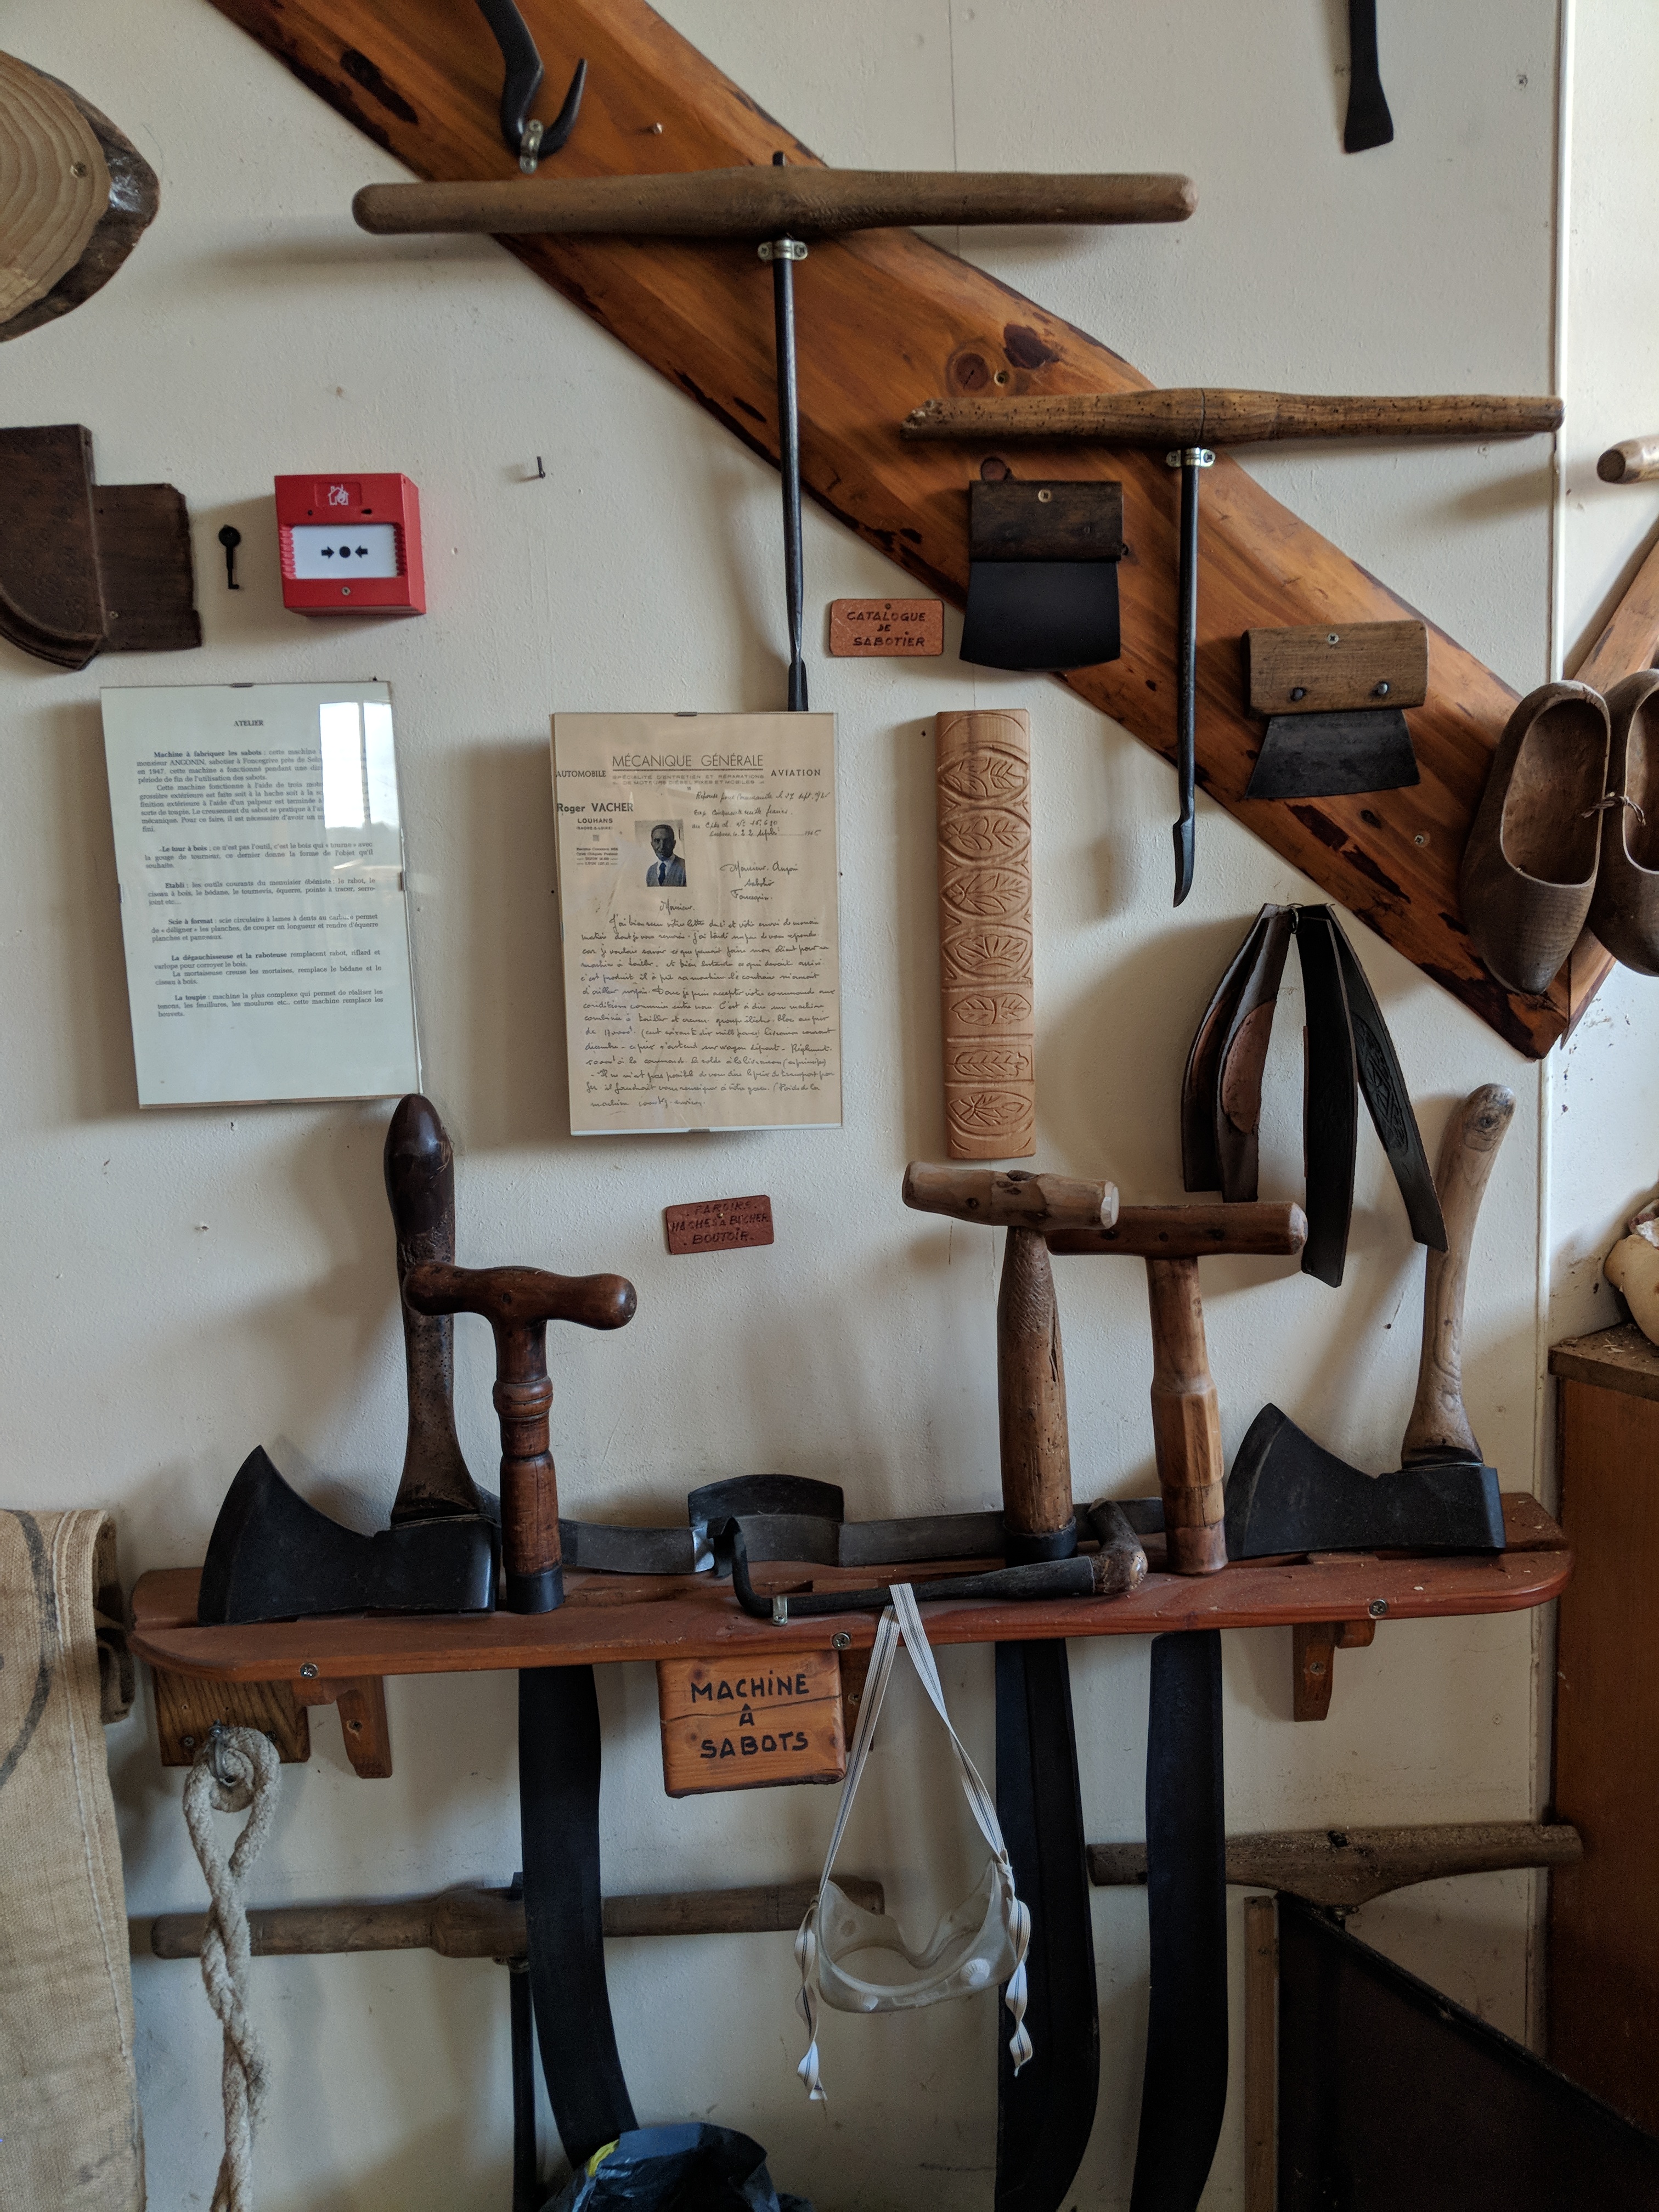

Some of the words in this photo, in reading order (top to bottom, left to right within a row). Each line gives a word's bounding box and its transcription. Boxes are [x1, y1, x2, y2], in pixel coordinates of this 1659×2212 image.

[847, 611, 926, 622] CATALOGUE
[877, 624, 891, 632] DE
[853, 636, 926, 647] SABOTIER
[612, 753, 692, 767] MÉCANIQUE
[701, 753, 764, 766] GÉNÉRALE
[556, 803, 585, 814] Roger
[591, 802, 634, 812] VACHER
[700, 1731, 809, 1759] SABOTS
